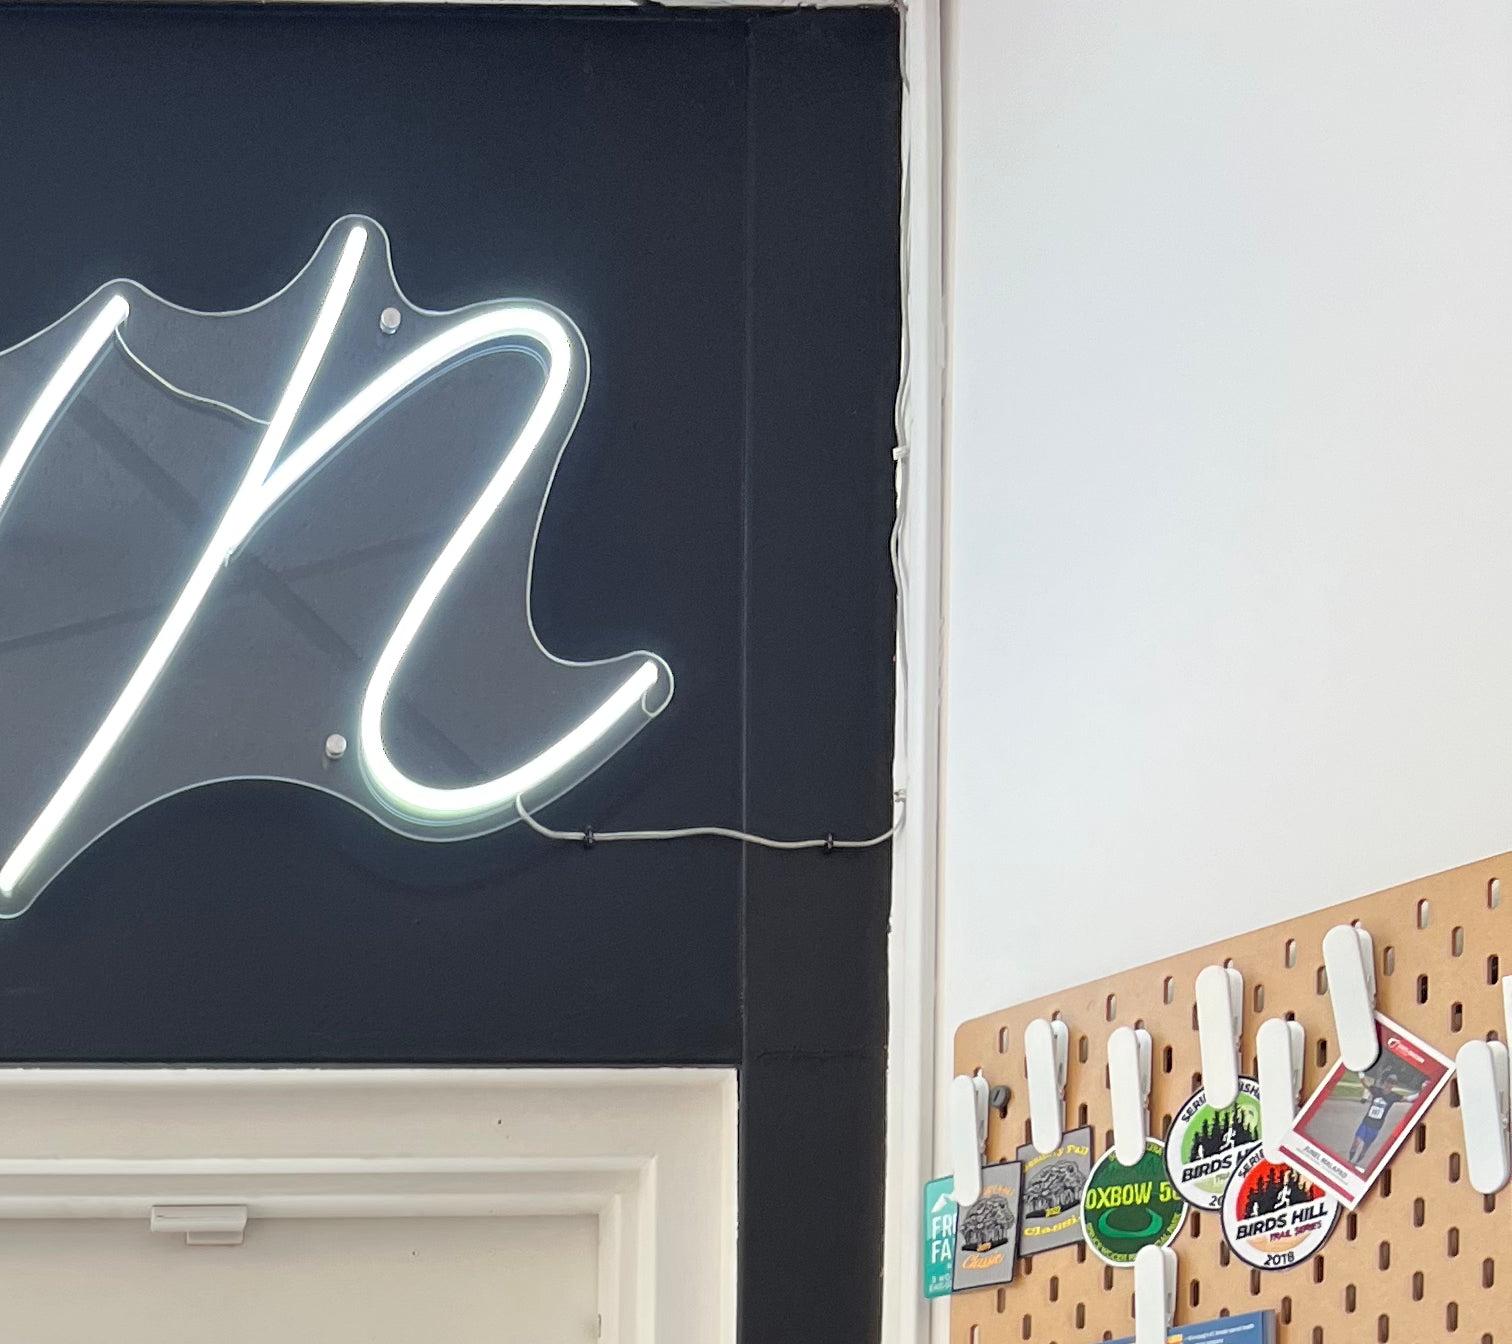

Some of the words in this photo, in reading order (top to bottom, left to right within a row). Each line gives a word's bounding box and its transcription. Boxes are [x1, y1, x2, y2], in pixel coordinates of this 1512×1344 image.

[1181, 1154, 1232, 1183] BIRDS
[1085, 1181, 1153, 1211] OXBOW
[1236, 1216, 1287, 1241] BIRDS
[1291, 1201, 1328, 1226] HILL
[1269, 1230, 1292, 1243] TRAIL
[931, 1238, 955, 1264] FA
[1264, 1251, 1295, 1266] 2018
